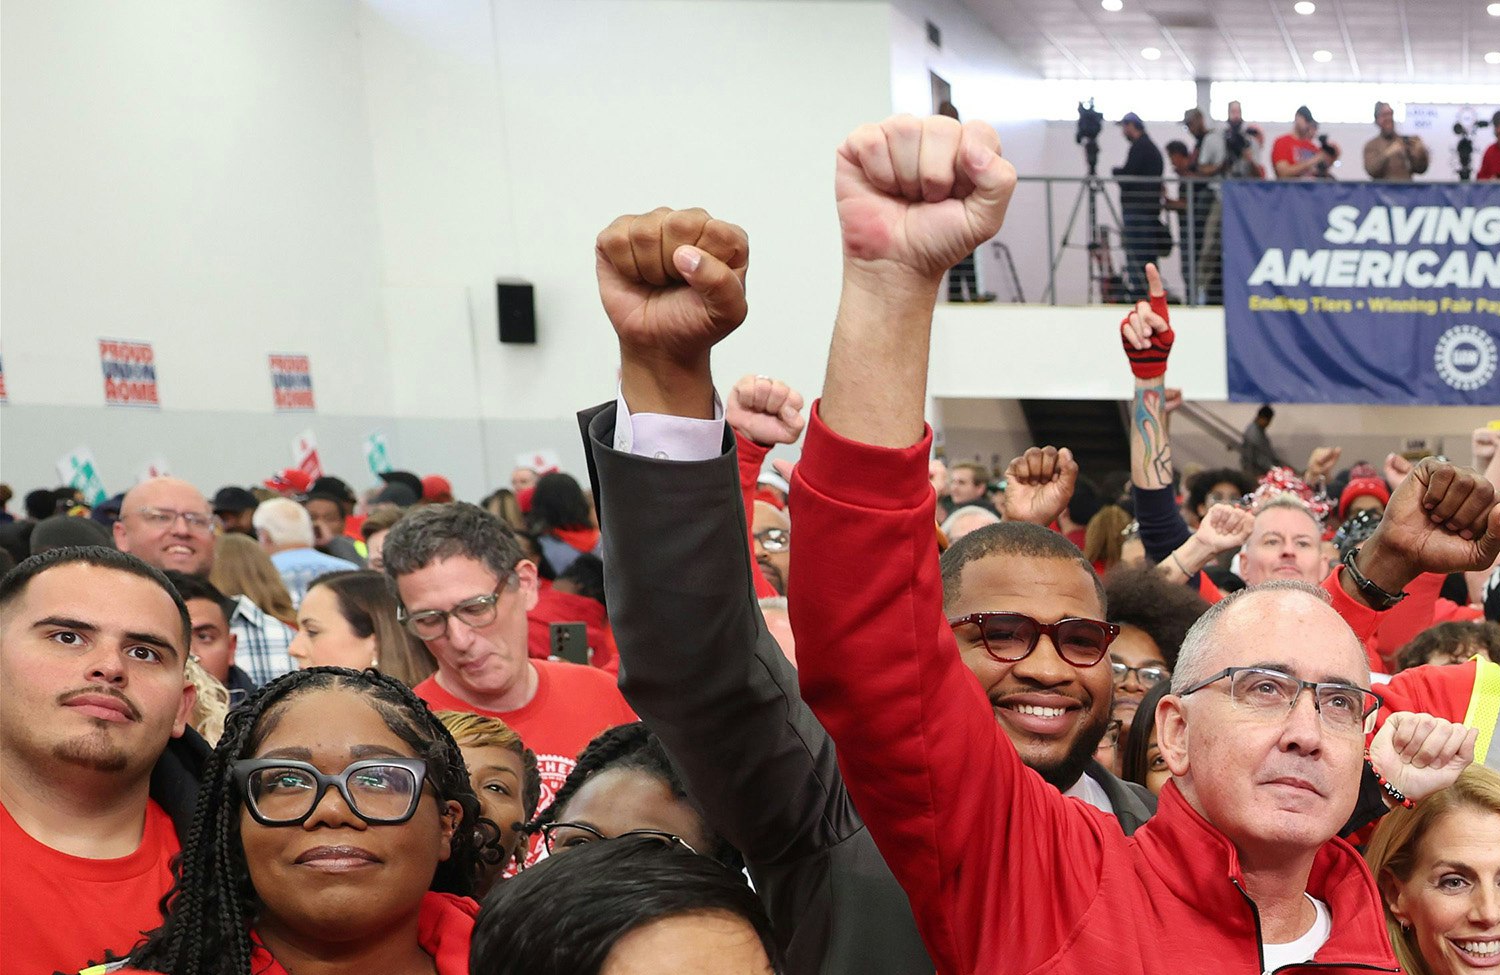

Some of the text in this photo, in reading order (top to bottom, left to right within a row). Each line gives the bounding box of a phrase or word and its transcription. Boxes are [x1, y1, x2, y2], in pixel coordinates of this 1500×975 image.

[1249, 295, 1308, 315] Ending
[1311, 296, 1352, 313] Tiers
[1368, 297, 1437, 315] Winning
[1440, 297, 1473, 313] Fair
[99, 340, 154, 363] PROUD
[102, 361, 157, 381] UNION
[269, 355, 310, 372] PROUD
